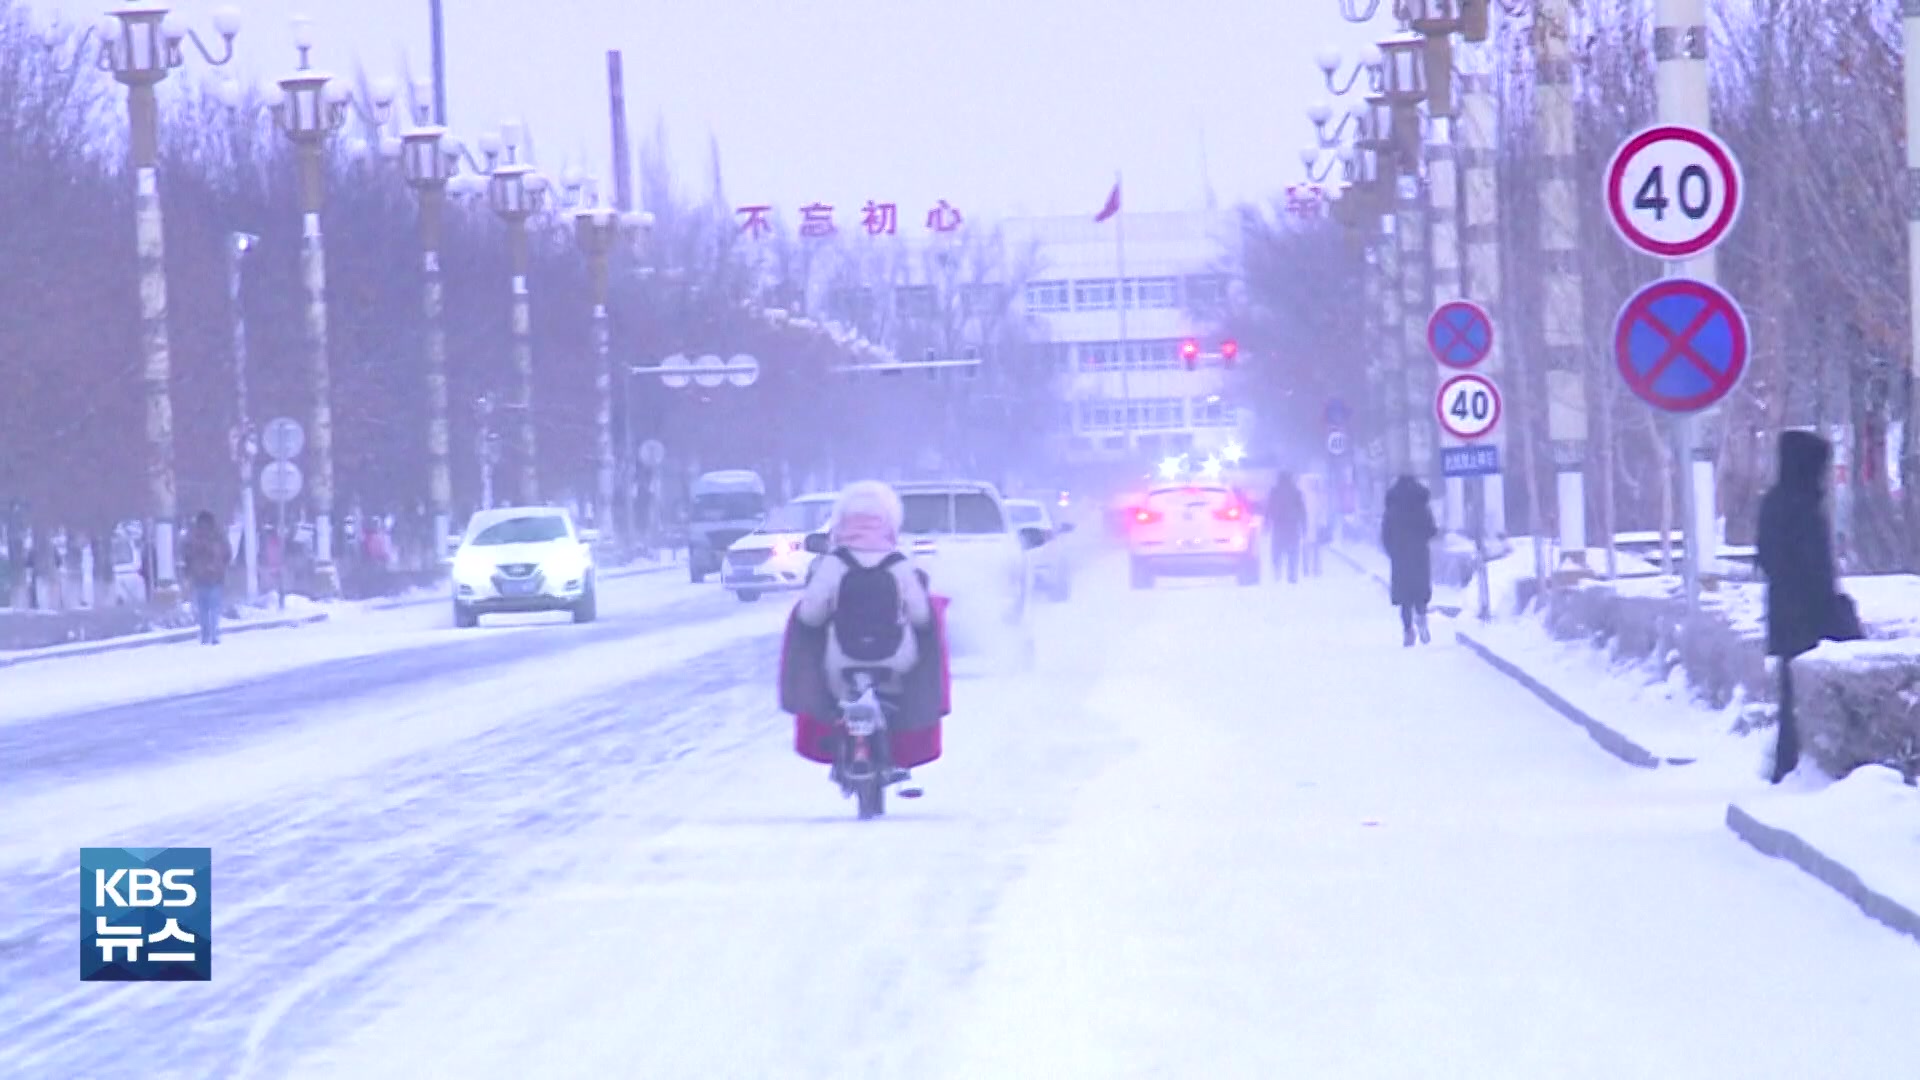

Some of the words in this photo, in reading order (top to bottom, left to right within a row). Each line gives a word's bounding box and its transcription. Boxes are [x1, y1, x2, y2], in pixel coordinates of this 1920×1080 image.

[1633, 164, 1711, 220] 40
[736, 200, 961, 239] 不忘初心
[1449, 390, 1488, 420] 40
